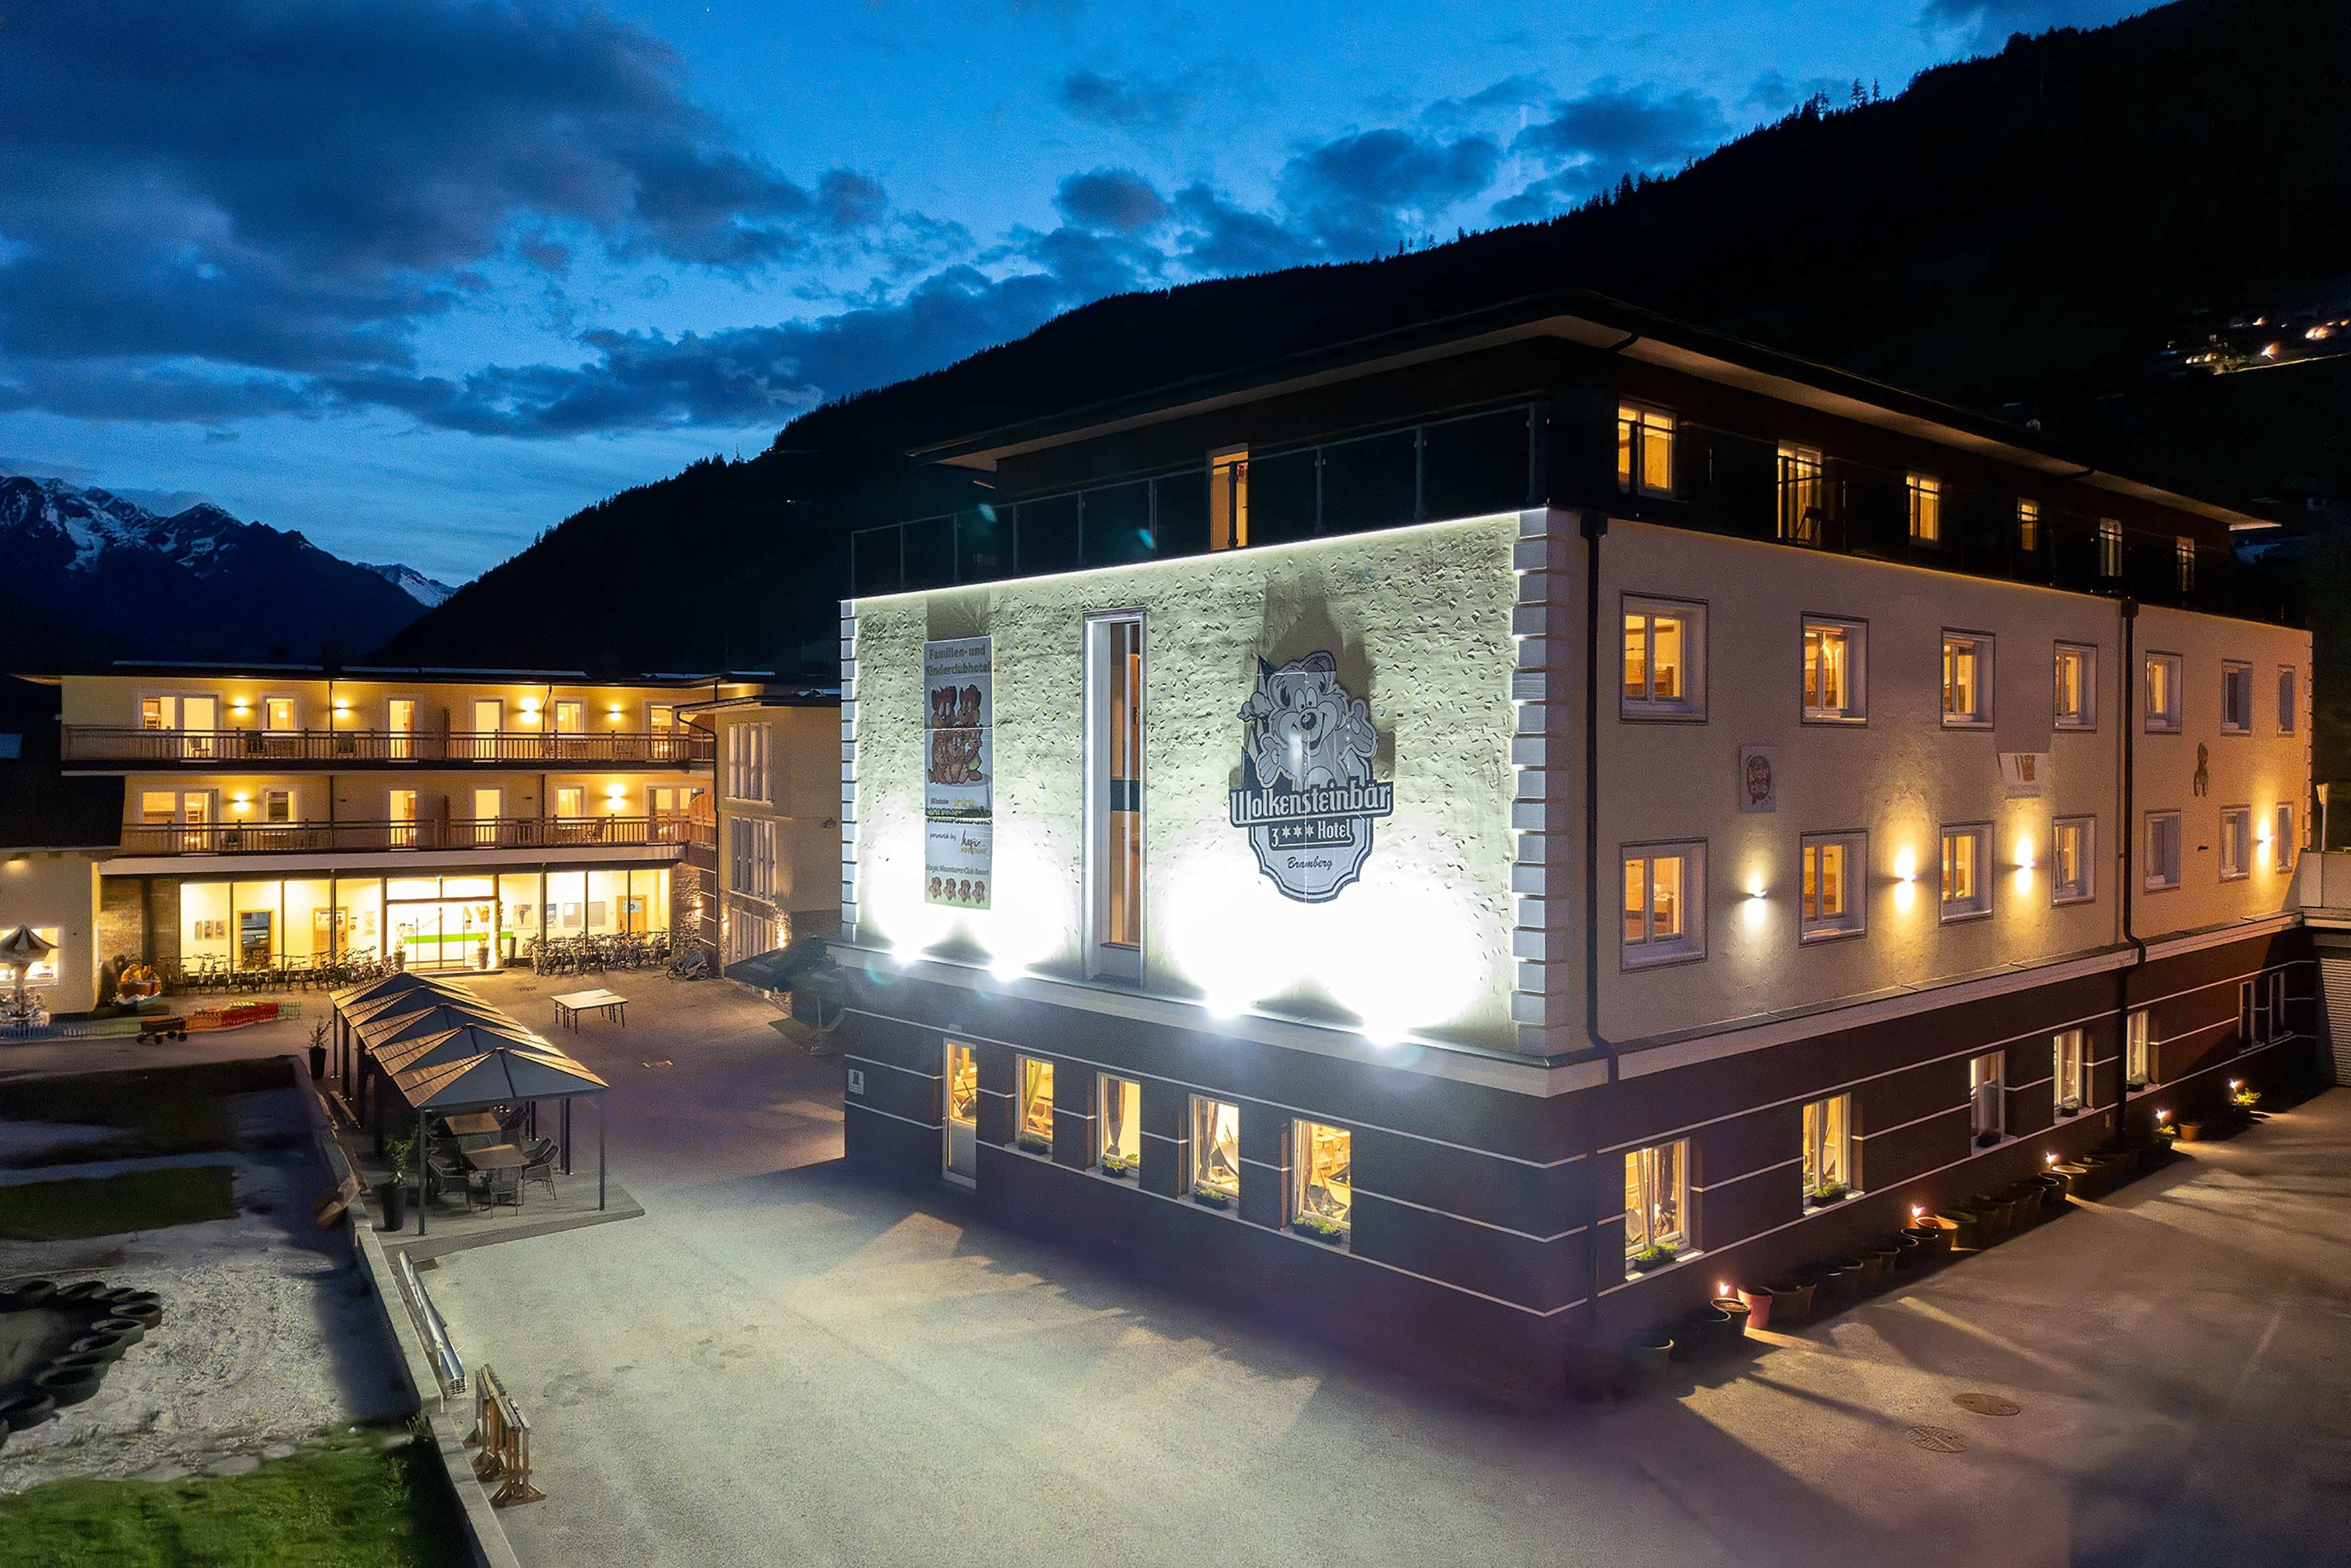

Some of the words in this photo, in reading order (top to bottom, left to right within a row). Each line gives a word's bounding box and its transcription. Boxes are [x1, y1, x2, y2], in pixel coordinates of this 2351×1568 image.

[929, 648, 967, 660] Familien-
[969, 644, 985, 656] und
[1230, 779, 1391, 823] Wolkensteinbär
[1317, 818, 1351, 840] Hotel
[1287, 855, 1332, 870] Bramberg
